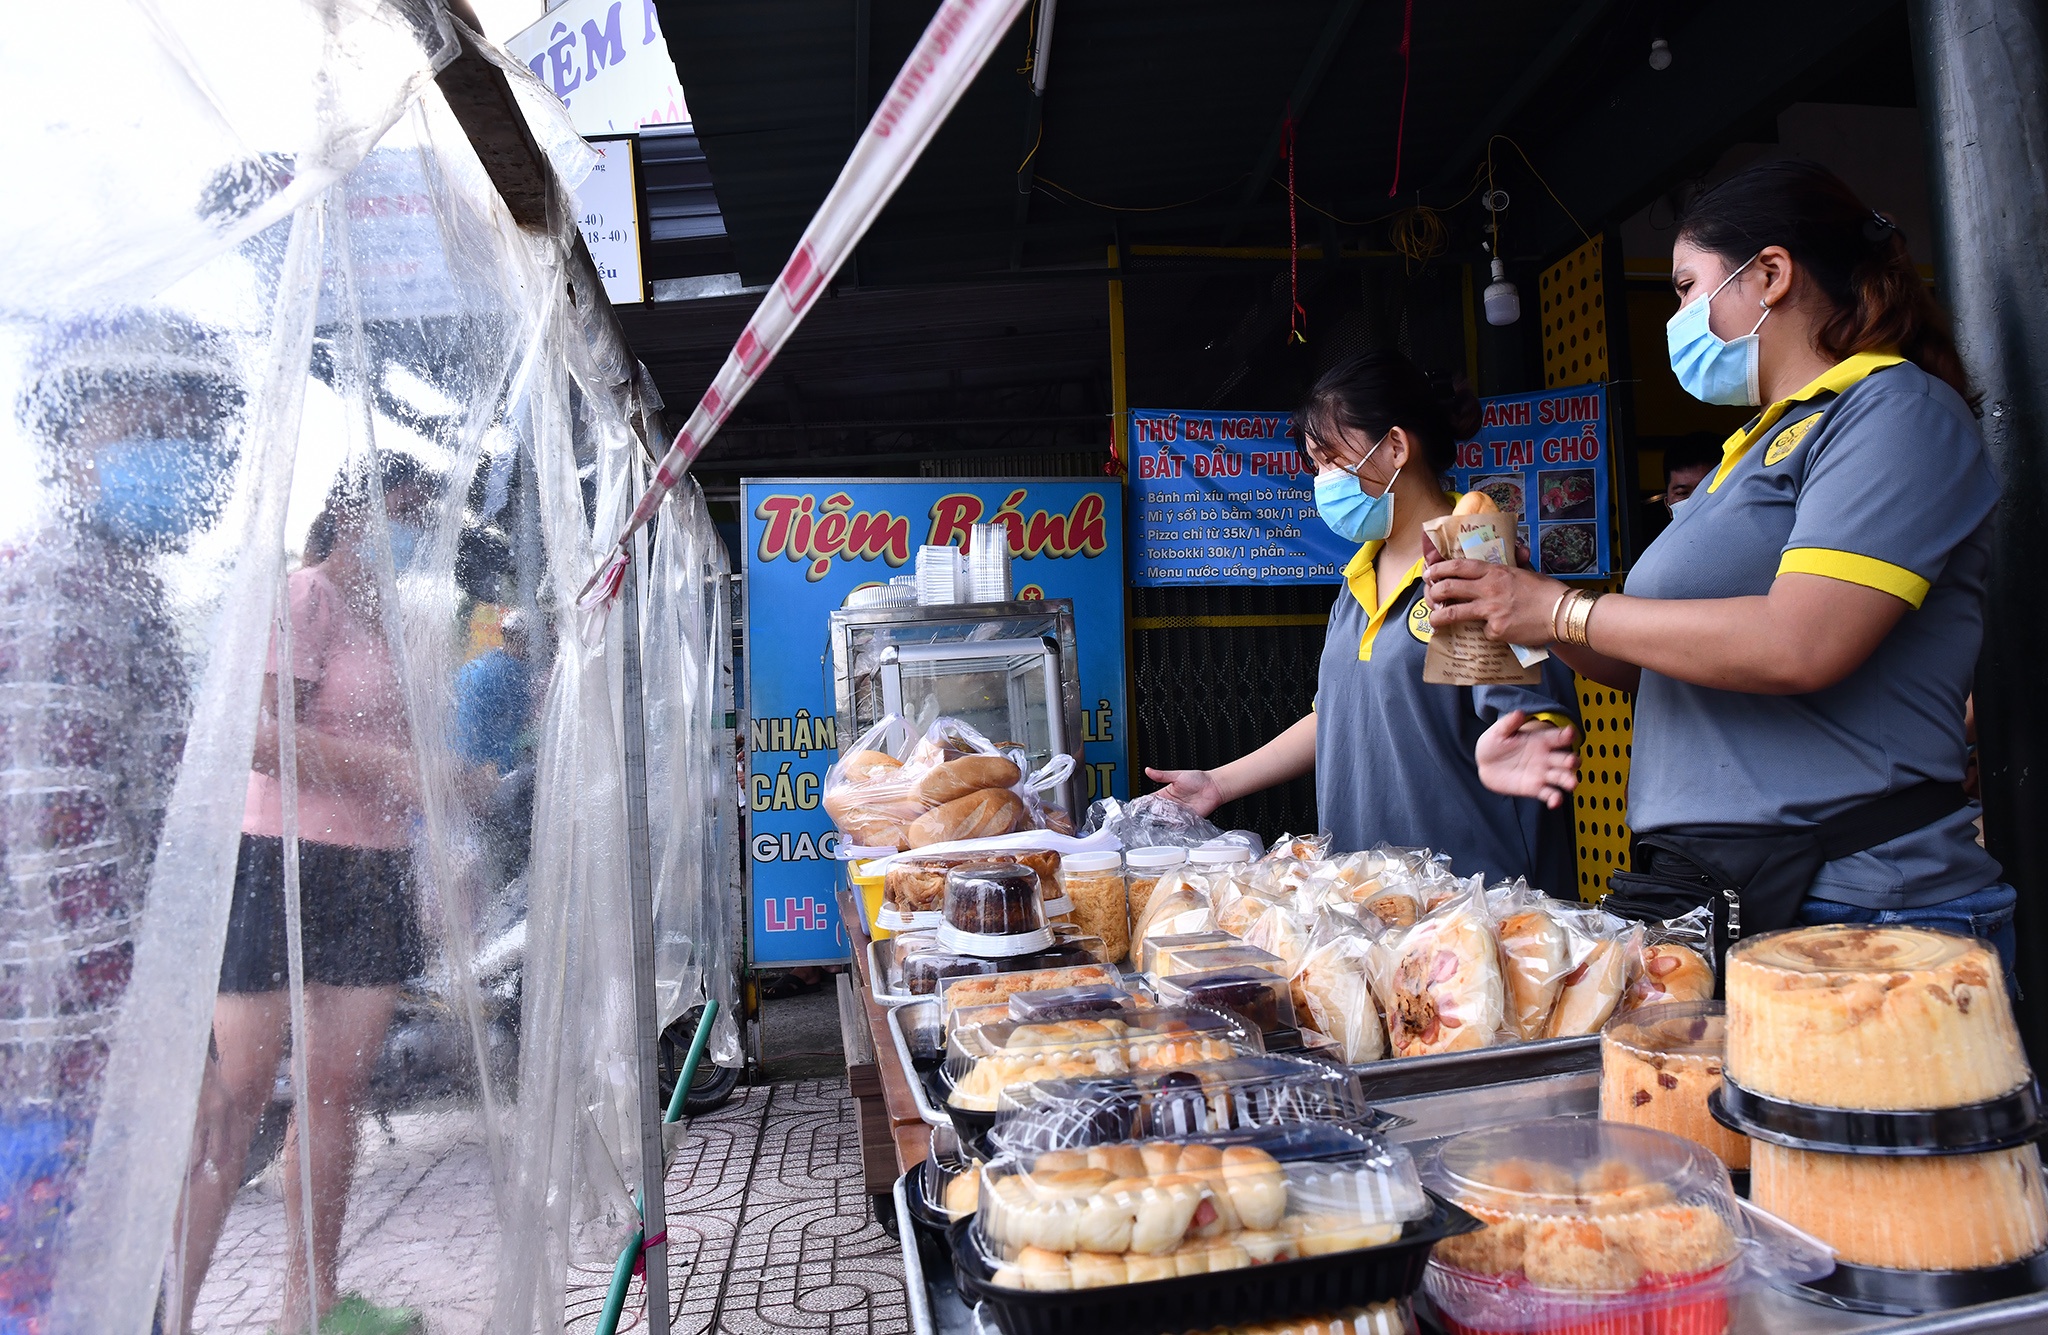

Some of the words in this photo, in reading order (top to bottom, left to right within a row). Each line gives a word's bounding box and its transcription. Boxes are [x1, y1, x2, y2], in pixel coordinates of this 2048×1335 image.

[585, 214, 597, 226] 40
[588, 231, 599, 243] 18
[609, 230, 620, 242] 40
[1135, 413, 1180, 442] THỨ
[1185, 418, 1215, 441] BA
[1221, 414, 1279, 440] NGÀY
[1482, 400, 1531, 427] ÁNH
[1538, 395, 1600, 425] SUMI
[1139, 446, 1187, 479] BẮT
[1193, 444, 1242, 478] ĐẦU
[1450, 442, 1483, 469] NG
[1489, 440, 1534, 472] TẠI
[1542, 423, 1600, 463] CHỖ
[1147, 491, 1180, 503] Bánh
[1184, 490, 1200, 502] mì
[1204, 490, 1223, 501] xíu
[1228, 490, 1252, 504] mại
[1256, 489, 1273, 500] bò
[1277, 487, 1312, 503] trứng
[1148, 510, 1162, 521] Mì
[1166, 509, 1173, 524] ý
[1177, 507, 1197, 520] sốt
[1201, 508, 1217, 520] bò
[1256, 508, 1293, 522] 30k/1
[756, 491, 910, 582] Tiệm
[928, 488, 1108, 559] Bánh
[1148, 530, 1179, 540] Pizza
[1183, 527, 1203, 539] chỉ
[1206, 527, 1220, 539] từ
[1223, 527, 1260, 540] 35k/1
[1266, 524, 1301, 540] phần
[1147, 547, 1203, 559] Tokbokki
[1207, 546, 1245, 558] 30k/1
[1250, 542, 1285, 557] phần
[1147, 567, 1182, 578] Menu
[1187, 565, 1219, 577] nước
[1223, 563, 1257, 579] uống
[1262, 565, 1303, 577] phong
[1309, 563, 1334, 576] phú
[751, 709, 837, 758] NHẬN
[751, 762, 819, 812] CÁC
[765, 897, 828, 932] LH:
